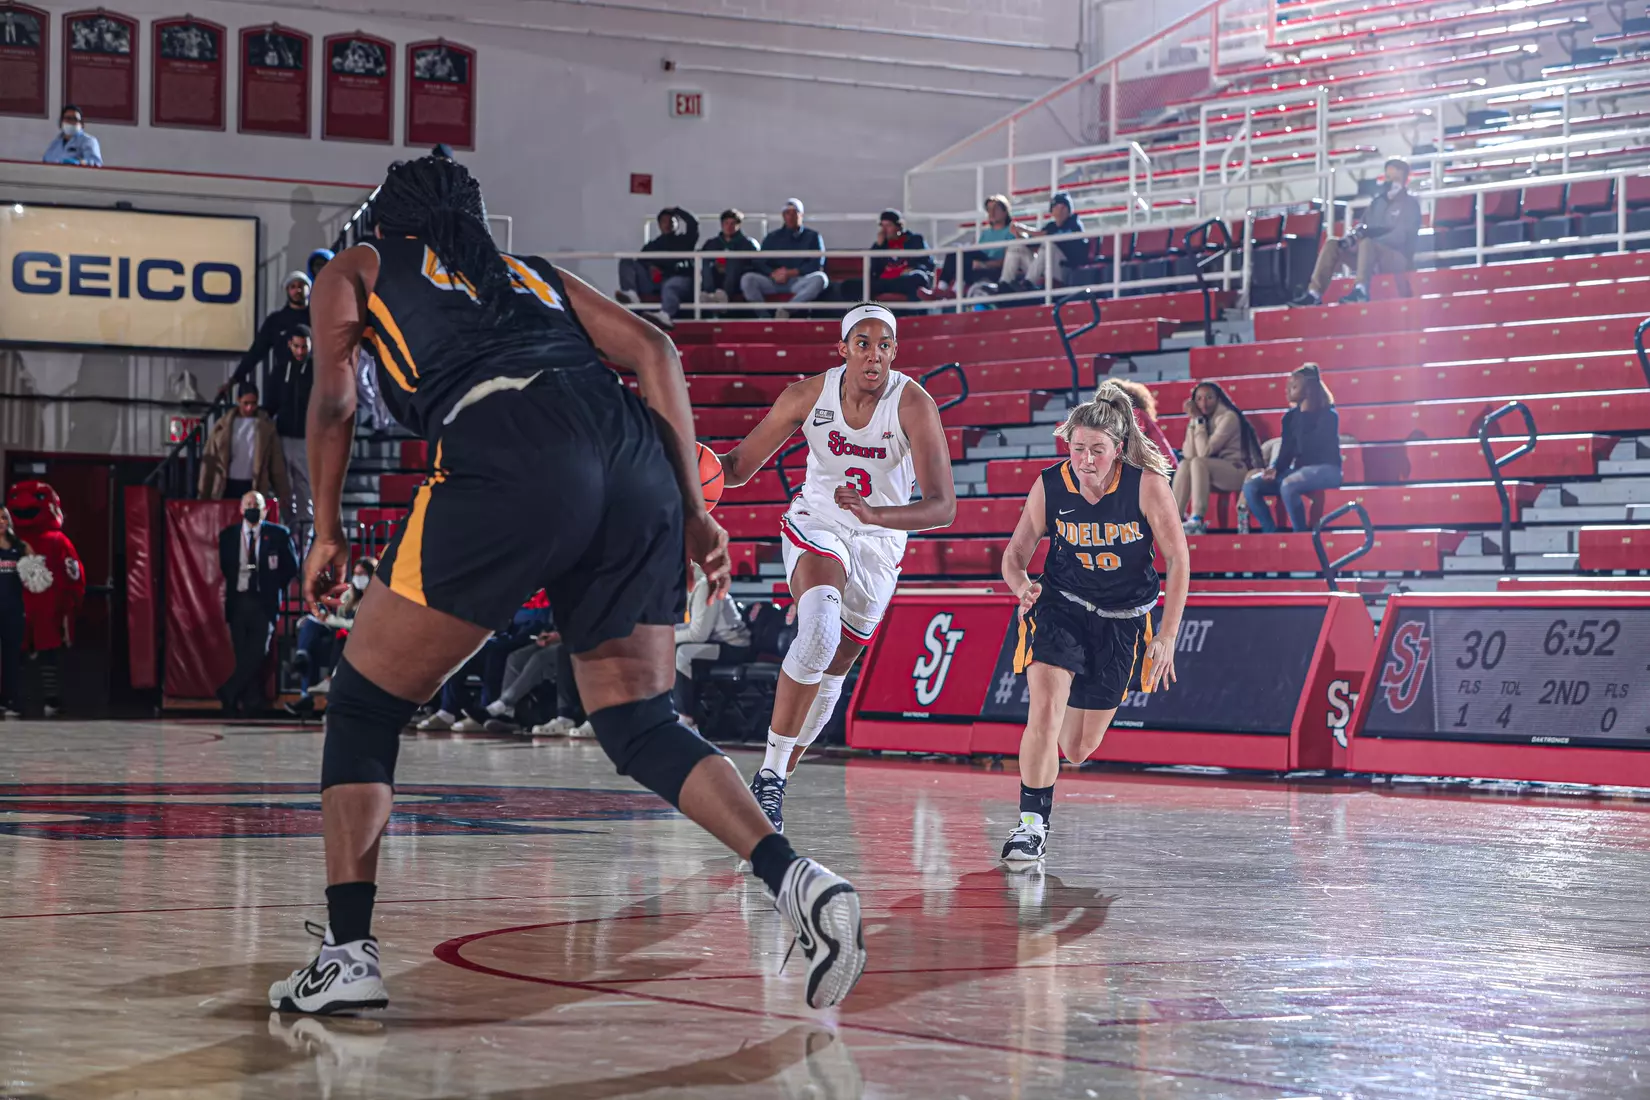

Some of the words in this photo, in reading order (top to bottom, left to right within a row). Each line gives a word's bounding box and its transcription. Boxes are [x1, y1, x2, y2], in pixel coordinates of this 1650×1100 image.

[676, 93, 702, 115] EXIT
[12, 251, 242, 305] GEICO
[845, 466, 872, 498] 3
[1075, 551, 1122, 571] 10
[1544, 619, 1621, 656] 6:52
[1456, 630, 1507, 670] 30
[1458, 680, 1481, 694] FLS
[1501, 681, 1521, 696] TOL
[1539, 680, 1590, 705] 2ND
[1604, 683, 1629, 699] FLS
[1453, 703, 1469, 727] 1
[1496, 703, 1512, 729] 4
[1600, 707, 1617, 733] 0
[1531, 736, 1570, 744] DAKTRONICS
